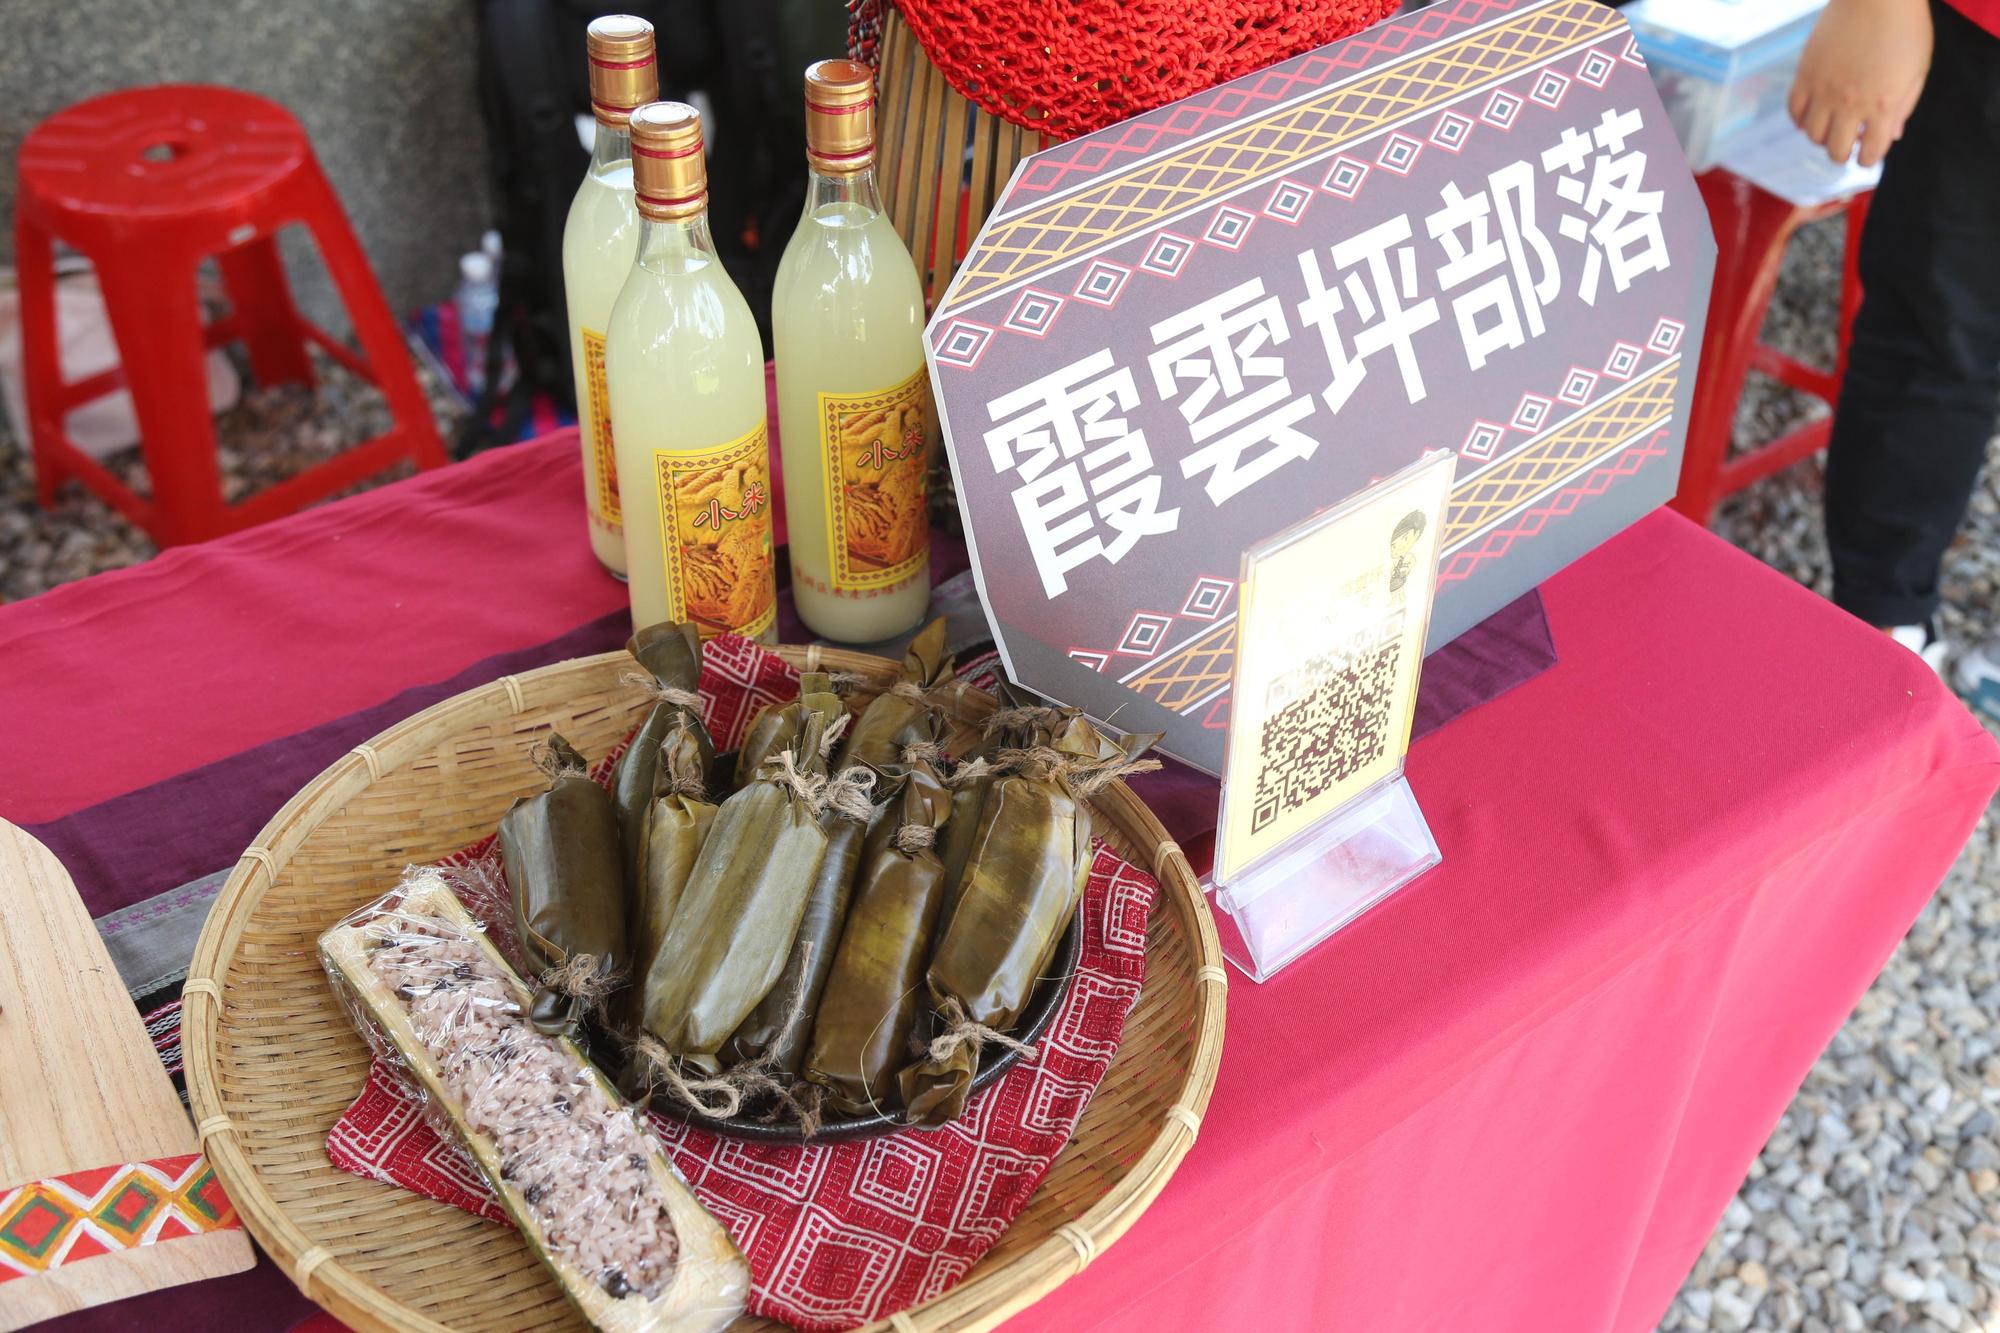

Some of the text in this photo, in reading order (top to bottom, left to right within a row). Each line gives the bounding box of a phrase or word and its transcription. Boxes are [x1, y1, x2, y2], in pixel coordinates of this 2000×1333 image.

[983, 107, 1671, 600] 霞雲坪部落
[856, 422, 926, 470] 小米
[693, 481, 766, 530] 小米
